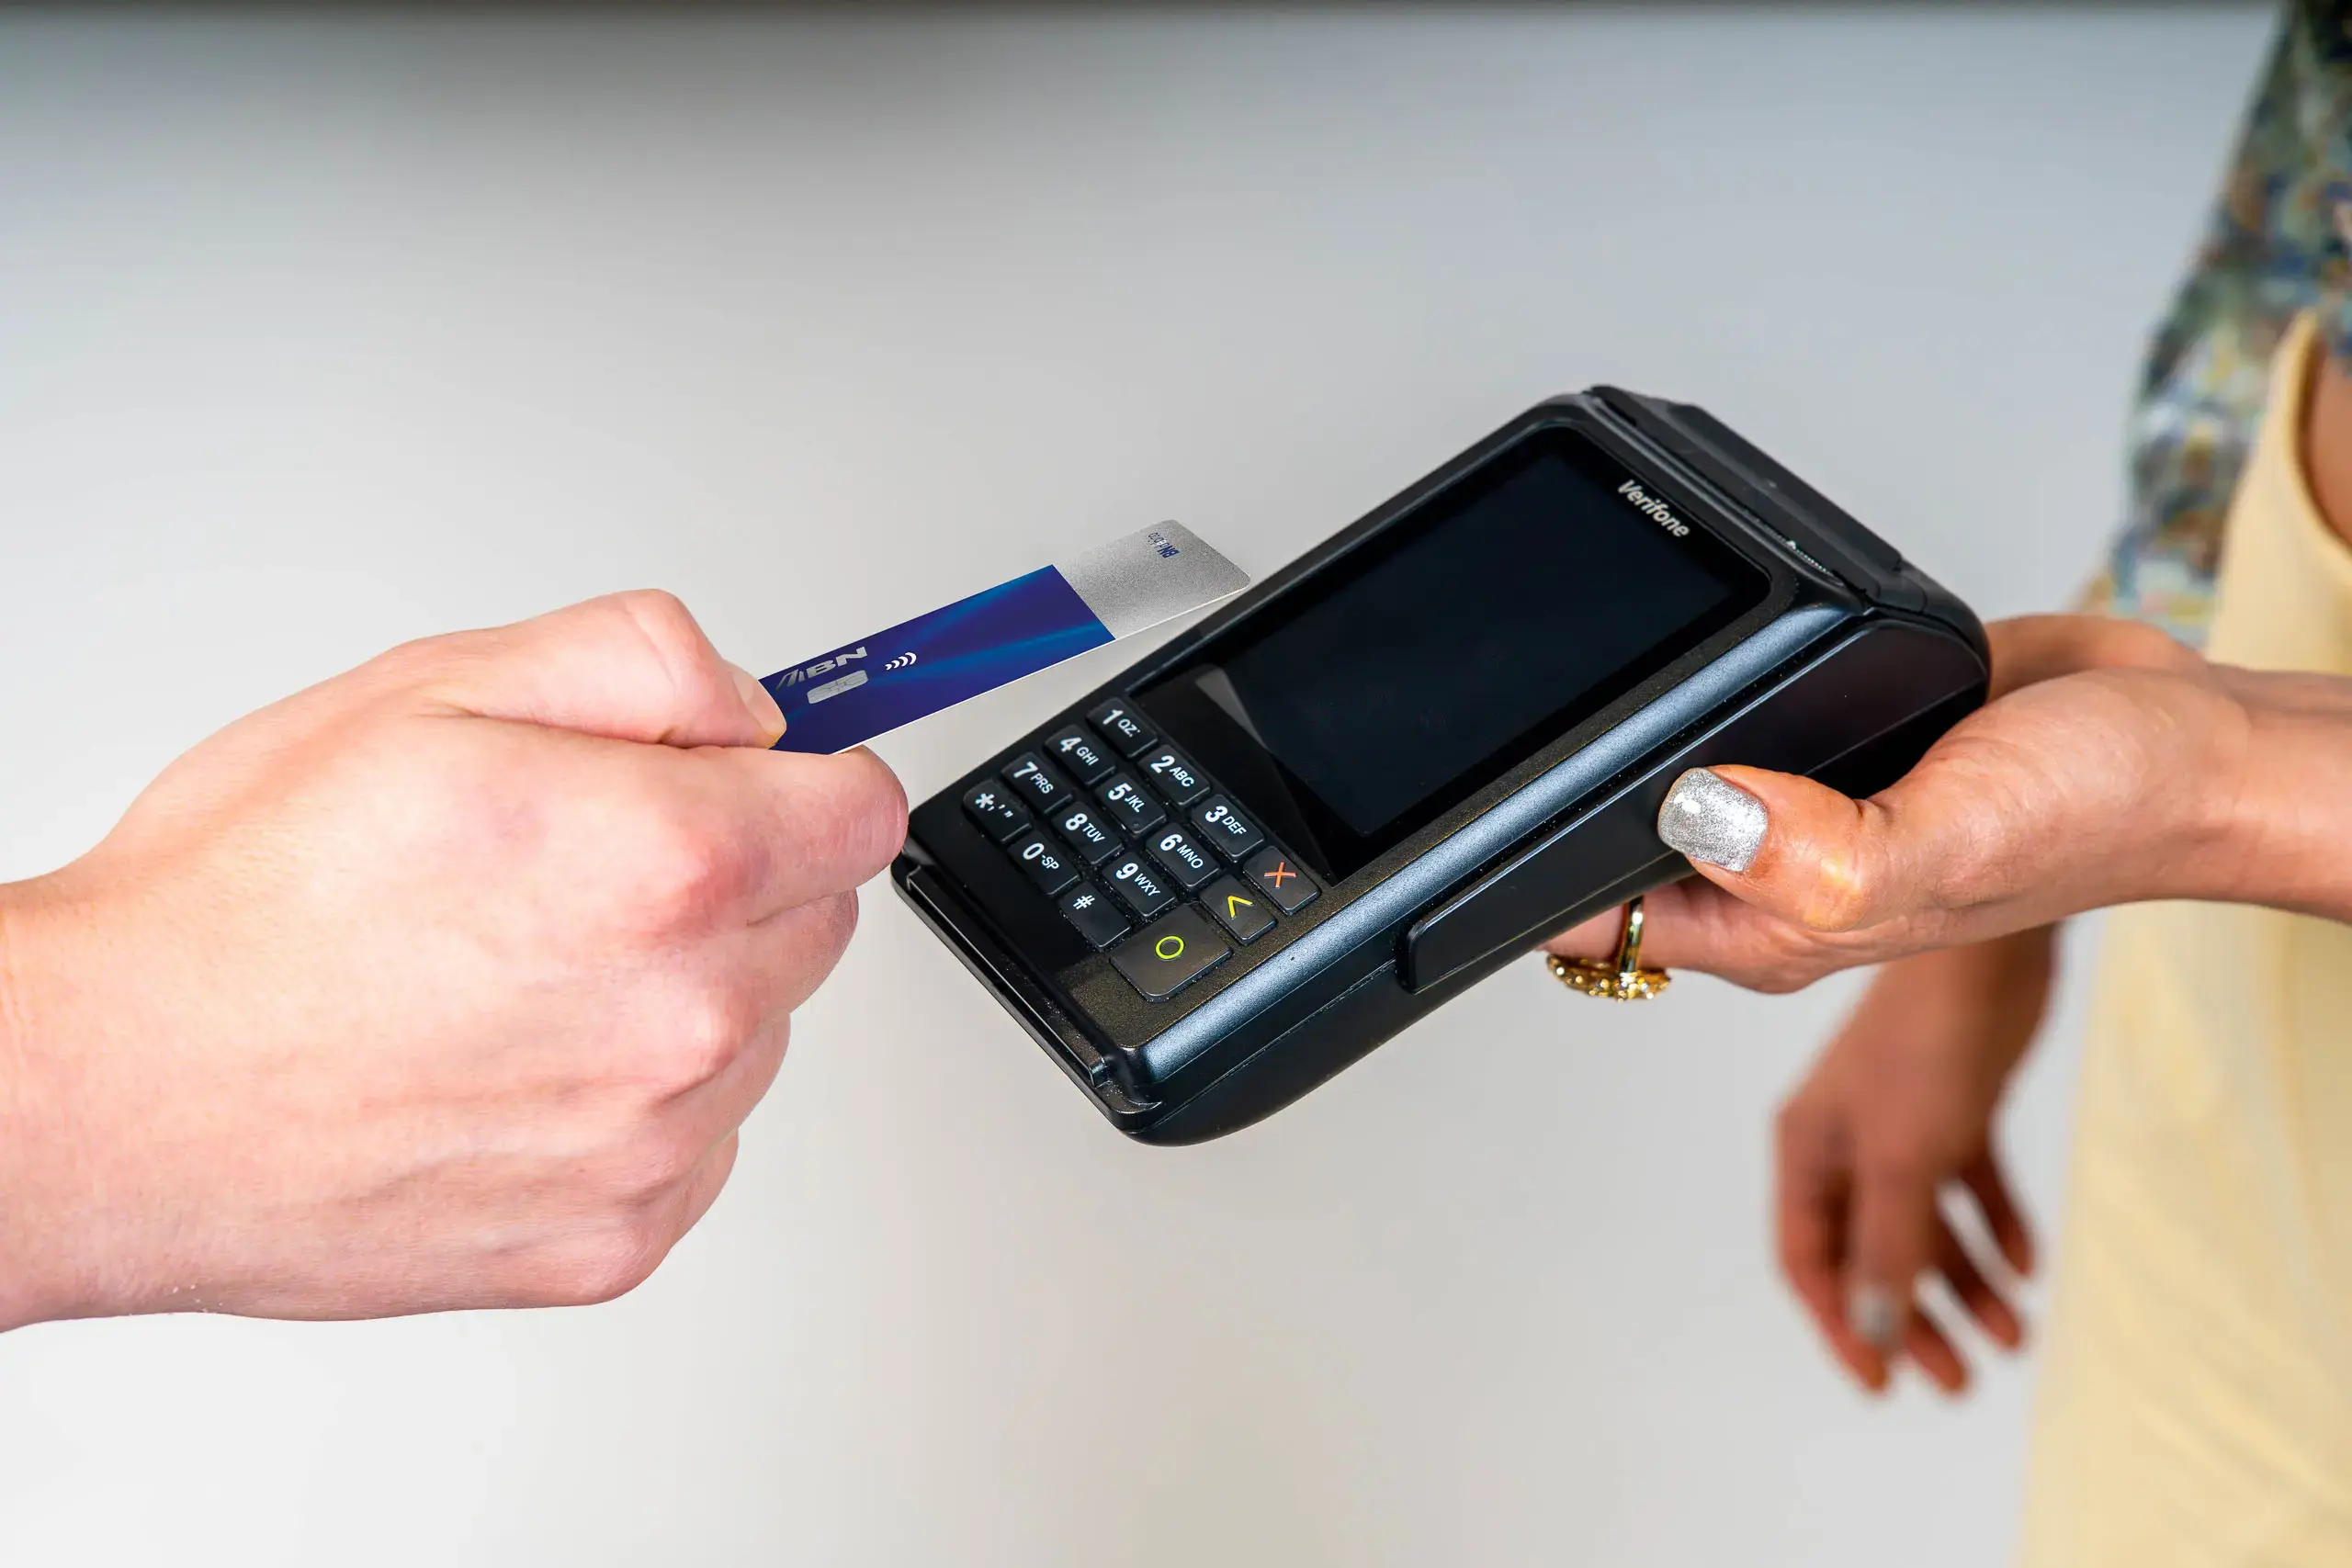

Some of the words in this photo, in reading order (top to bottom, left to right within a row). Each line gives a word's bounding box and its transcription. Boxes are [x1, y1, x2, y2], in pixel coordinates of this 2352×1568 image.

[1617, 479, 1690, 538] Verifone
[1103, 709, 1124, 725] 1
[1060, 737, 1082, 752] 4
[1076, 746, 1100, 766] GHI
[1013, 761, 1039, 778] 7
[1030, 773, 1054, 795] PRS
[1150, 754, 1176, 774] 2
[1169, 766, 1195, 787] ABC
[1107, 782, 1133, 801] 5
[1124, 795, 1145, 813] JKL
[1065, 812, 1089, 831] 8
[1082, 822, 1105, 842] TUV
[1204, 805, 1228, 823] 3
[1221, 815, 1248, 835] DEF
[1023, 842, 1045, 861] 0
[1159, 833, 1183, 852] 6
[1176, 843, 1204, 869] MNO
[1115, 863, 1139, 880] 9
[1134, 873, 1161, 897] WXY
